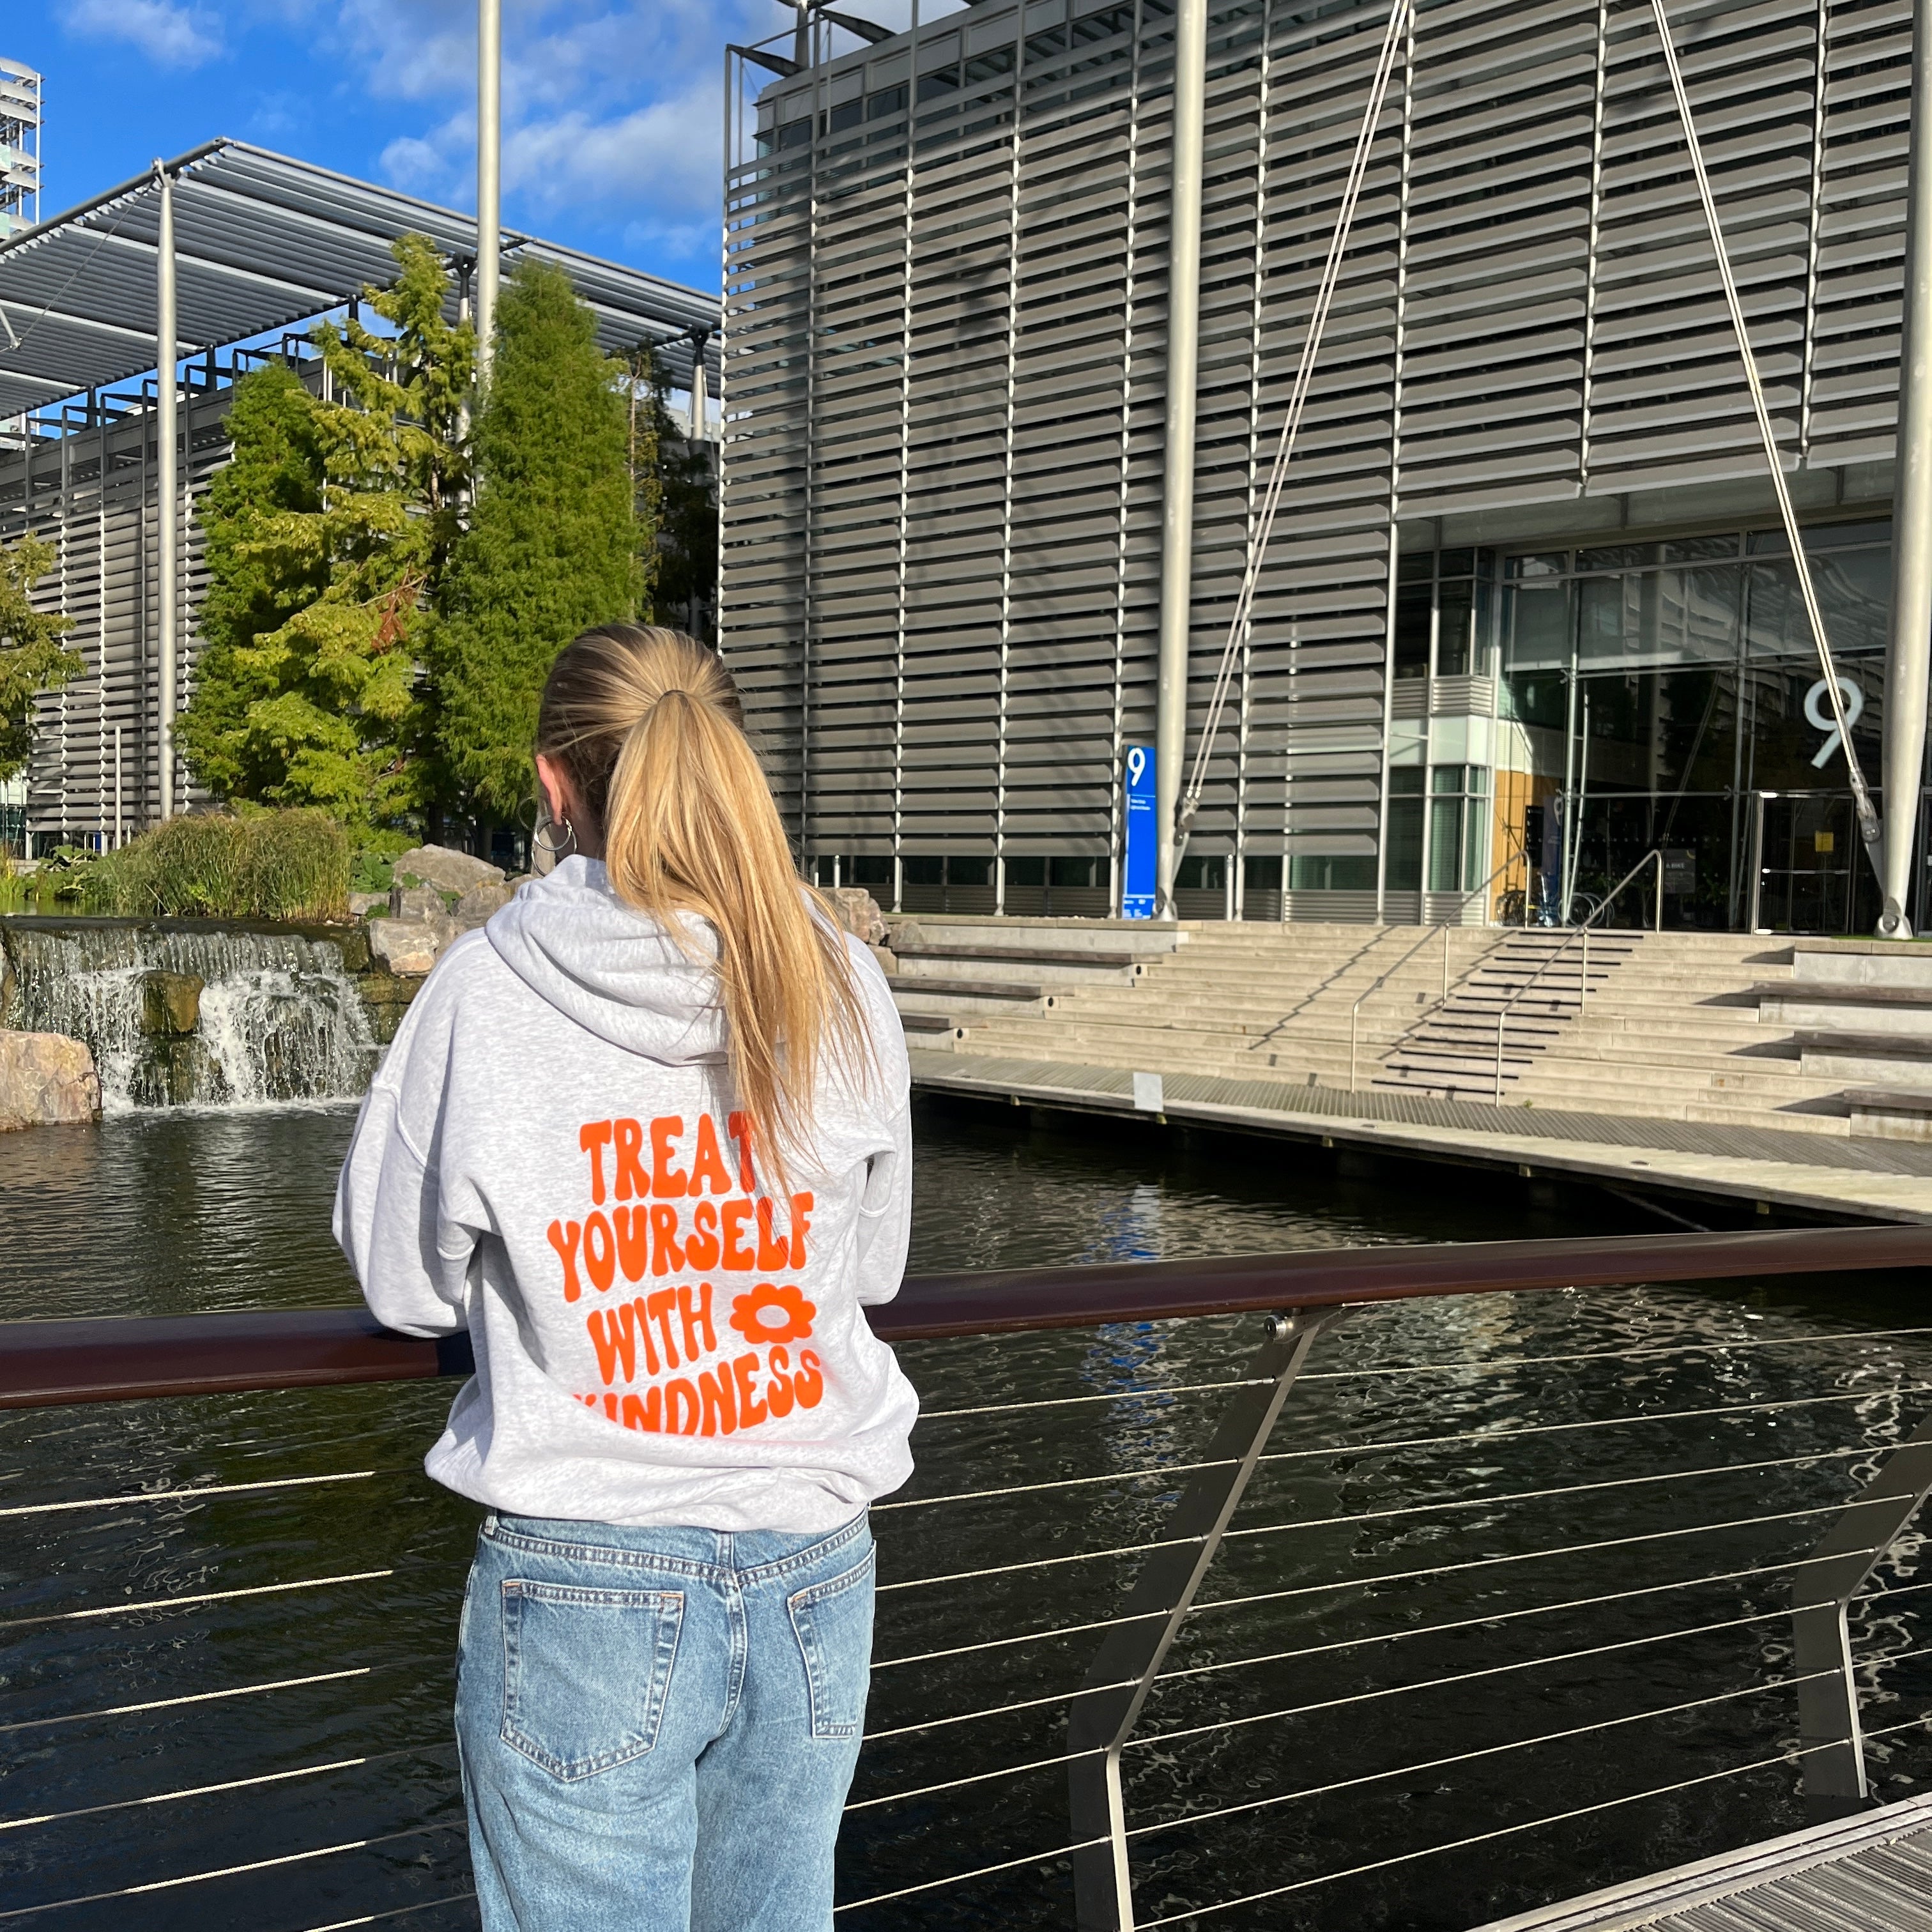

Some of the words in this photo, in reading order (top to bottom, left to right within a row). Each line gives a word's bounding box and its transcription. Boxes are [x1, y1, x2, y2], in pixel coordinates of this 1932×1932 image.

[1128, 747, 1146, 786] 9
[1804, 676, 1863, 769] 9
[579, 1110, 758, 1206] TREAT
[547, 1191, 814, 1303] YOURSELF
[586, 1282, 717, 1386] WITH
[573, 1346, 823, 1438] NDNESS
